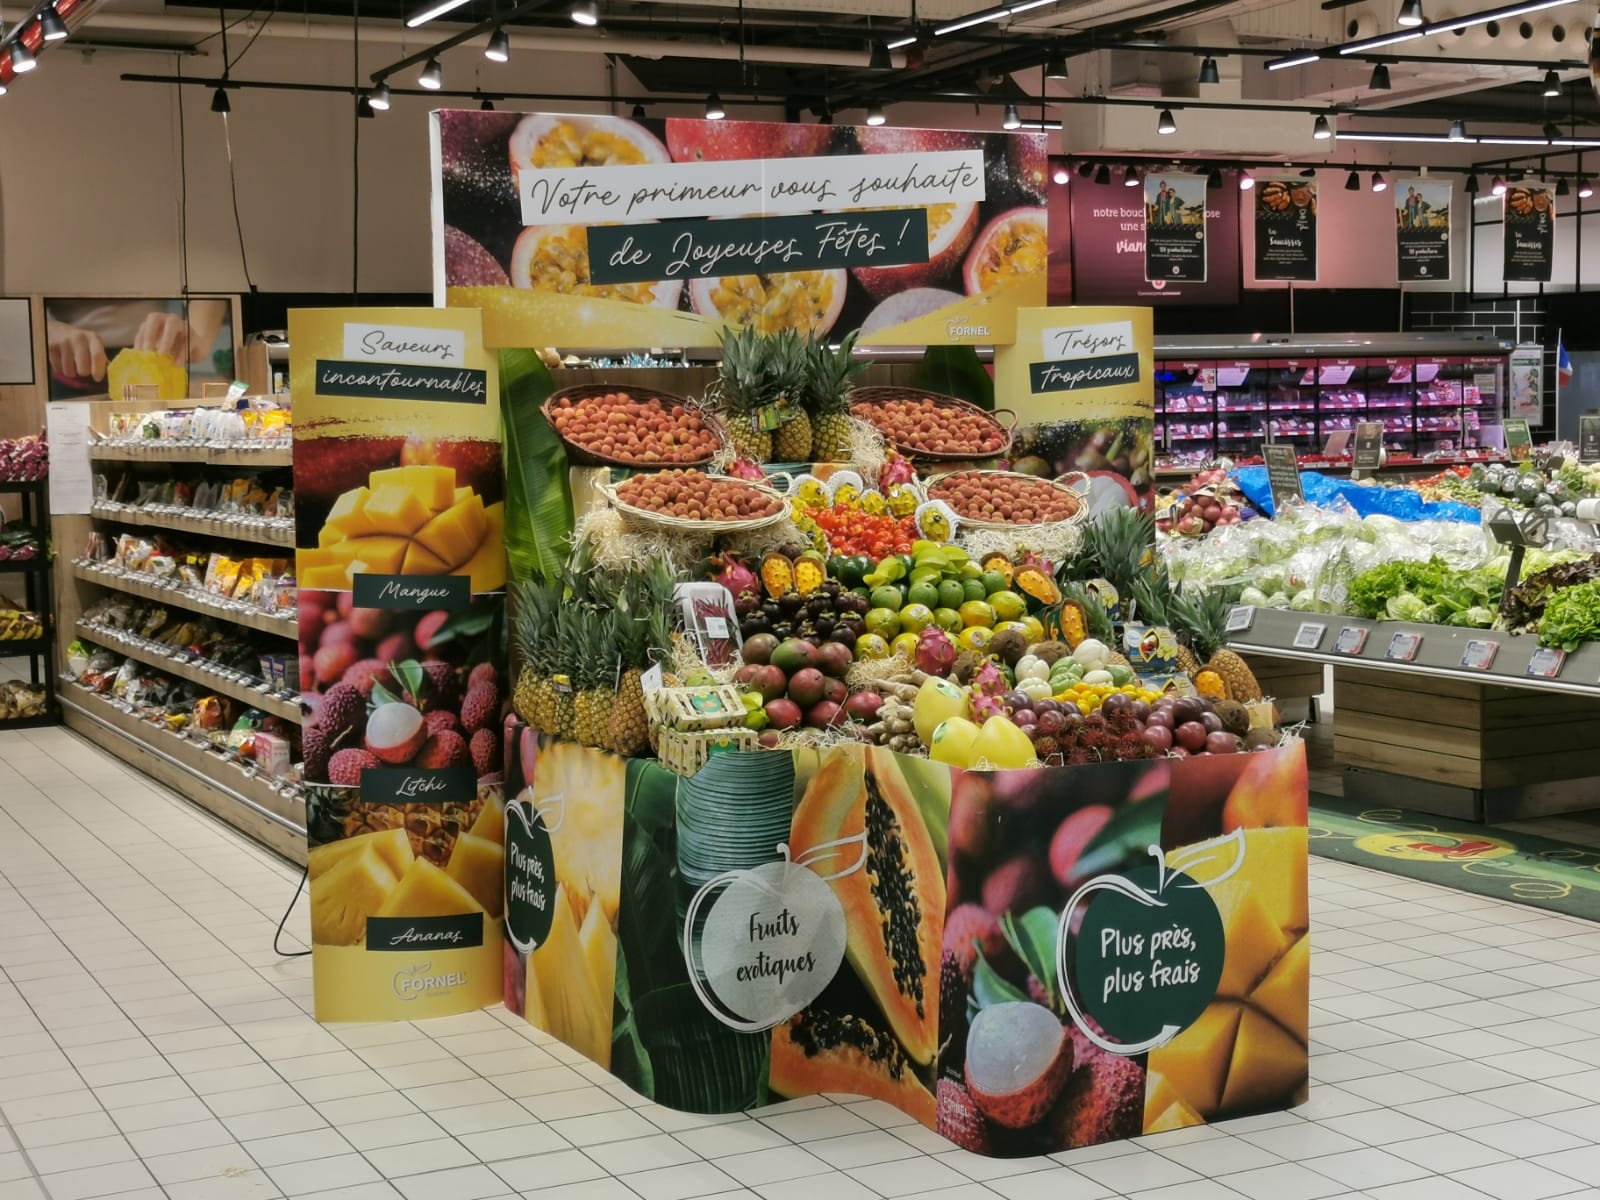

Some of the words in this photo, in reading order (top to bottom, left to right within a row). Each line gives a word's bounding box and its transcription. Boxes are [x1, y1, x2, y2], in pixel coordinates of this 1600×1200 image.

[531, 177, 621, 215] Votre
[626, 181, 762, 215] primeur
[770, 178, 837, 202] vous
[848, 161, 979, 203] souhaite
[1093, 208, 1119, 217] notre
[1120, 223, 1139, 231] une
[609, 236, 652, 266] de
[665, 232, 803, 276] Joyeuses
[815, 221, 886, 259] Fêtes
[360, 330, 455, 360] Saveurs
[950, 326, 991, 337] FORNEL
[1054, 329, 1126, 356] Trésors
[322, 368, 486, 397] incontournables
[1040, 364, 1135, 390] tropicaux
[378, 580, 450, 604] Mangue
[395, 776, 447, 797] Litchi
[510, 842, 527, 872] Plus
[526, 855, 545, 884] près,
[510, 876, 526, 902] plus
[526, 881, 546, 912] frais
[389, 927, 464, 946] Ananas
[750, 908, 800, 943] Fruits
[1101, 928, 1145, 958] Plus
[1150, 923, 1197, 960] près,
[402, 971, 467, 993] FORNEL
[736, 951, 817, 985] exotiques
[1103, 966, 1145, 1004] plus
[1149, 959, 1201, 988] frais
